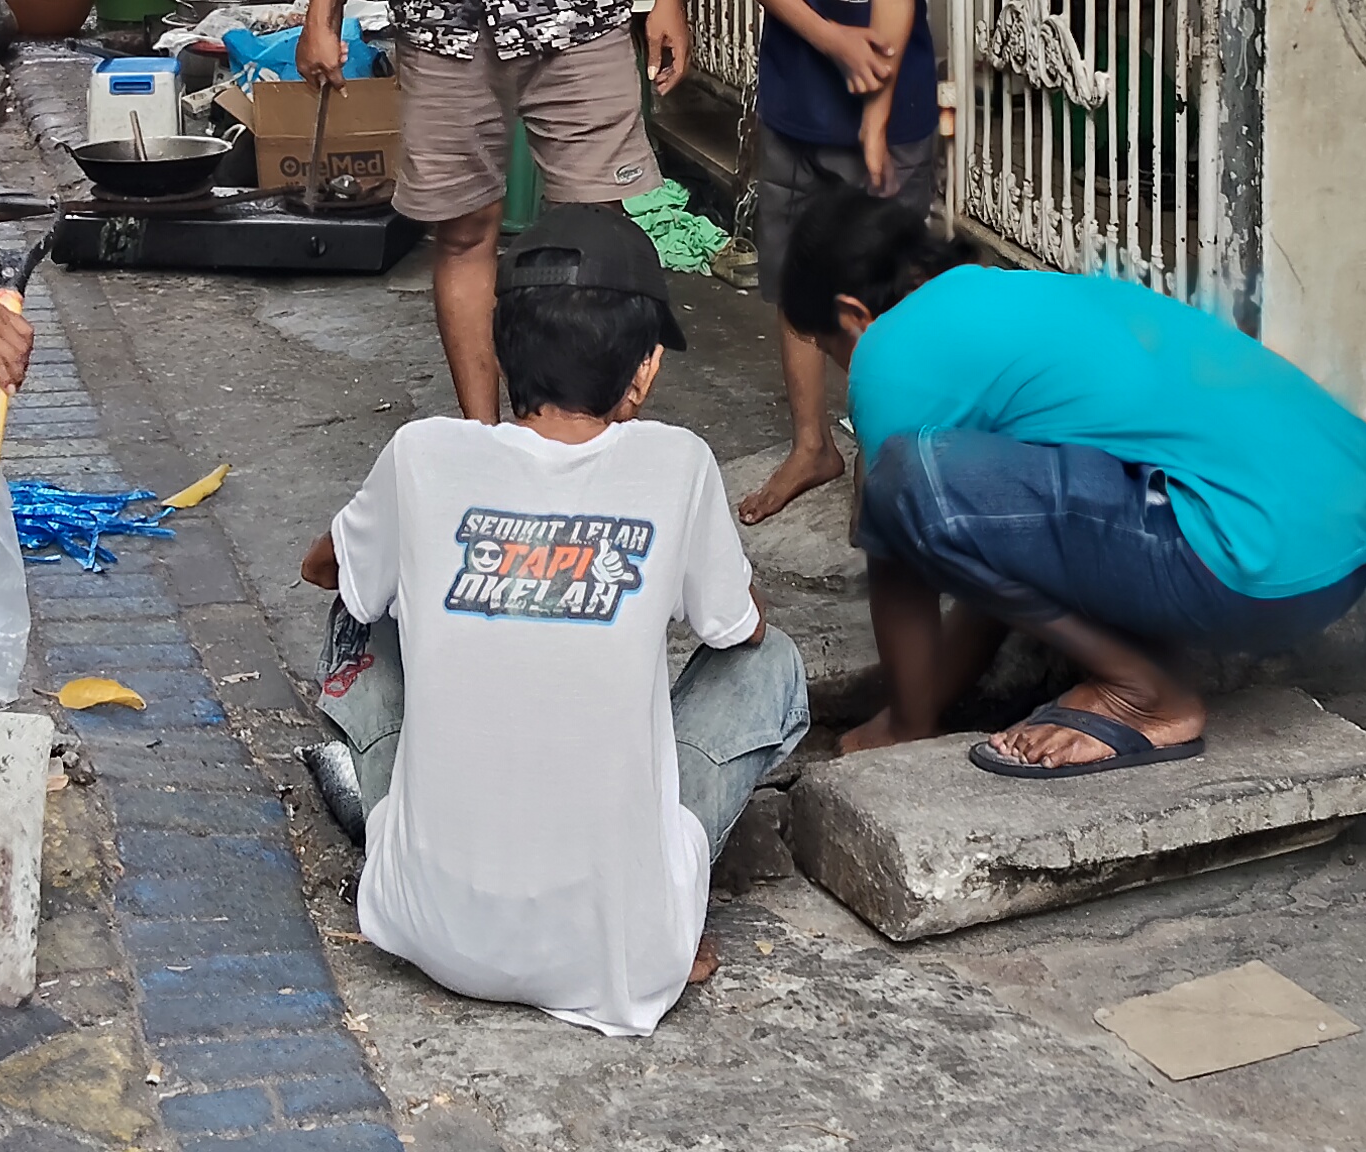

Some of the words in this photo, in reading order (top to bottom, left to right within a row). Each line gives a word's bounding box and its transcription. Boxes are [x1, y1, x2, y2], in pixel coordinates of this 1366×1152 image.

[280, 151, 385, 178] OneMed
[462, 513, 565, 545] SEDIKIT
[568, 520, 649, 552] LELAH
[497, 542, 595, 581] TAPI
[449, 573, 619, 616] OKELAH
